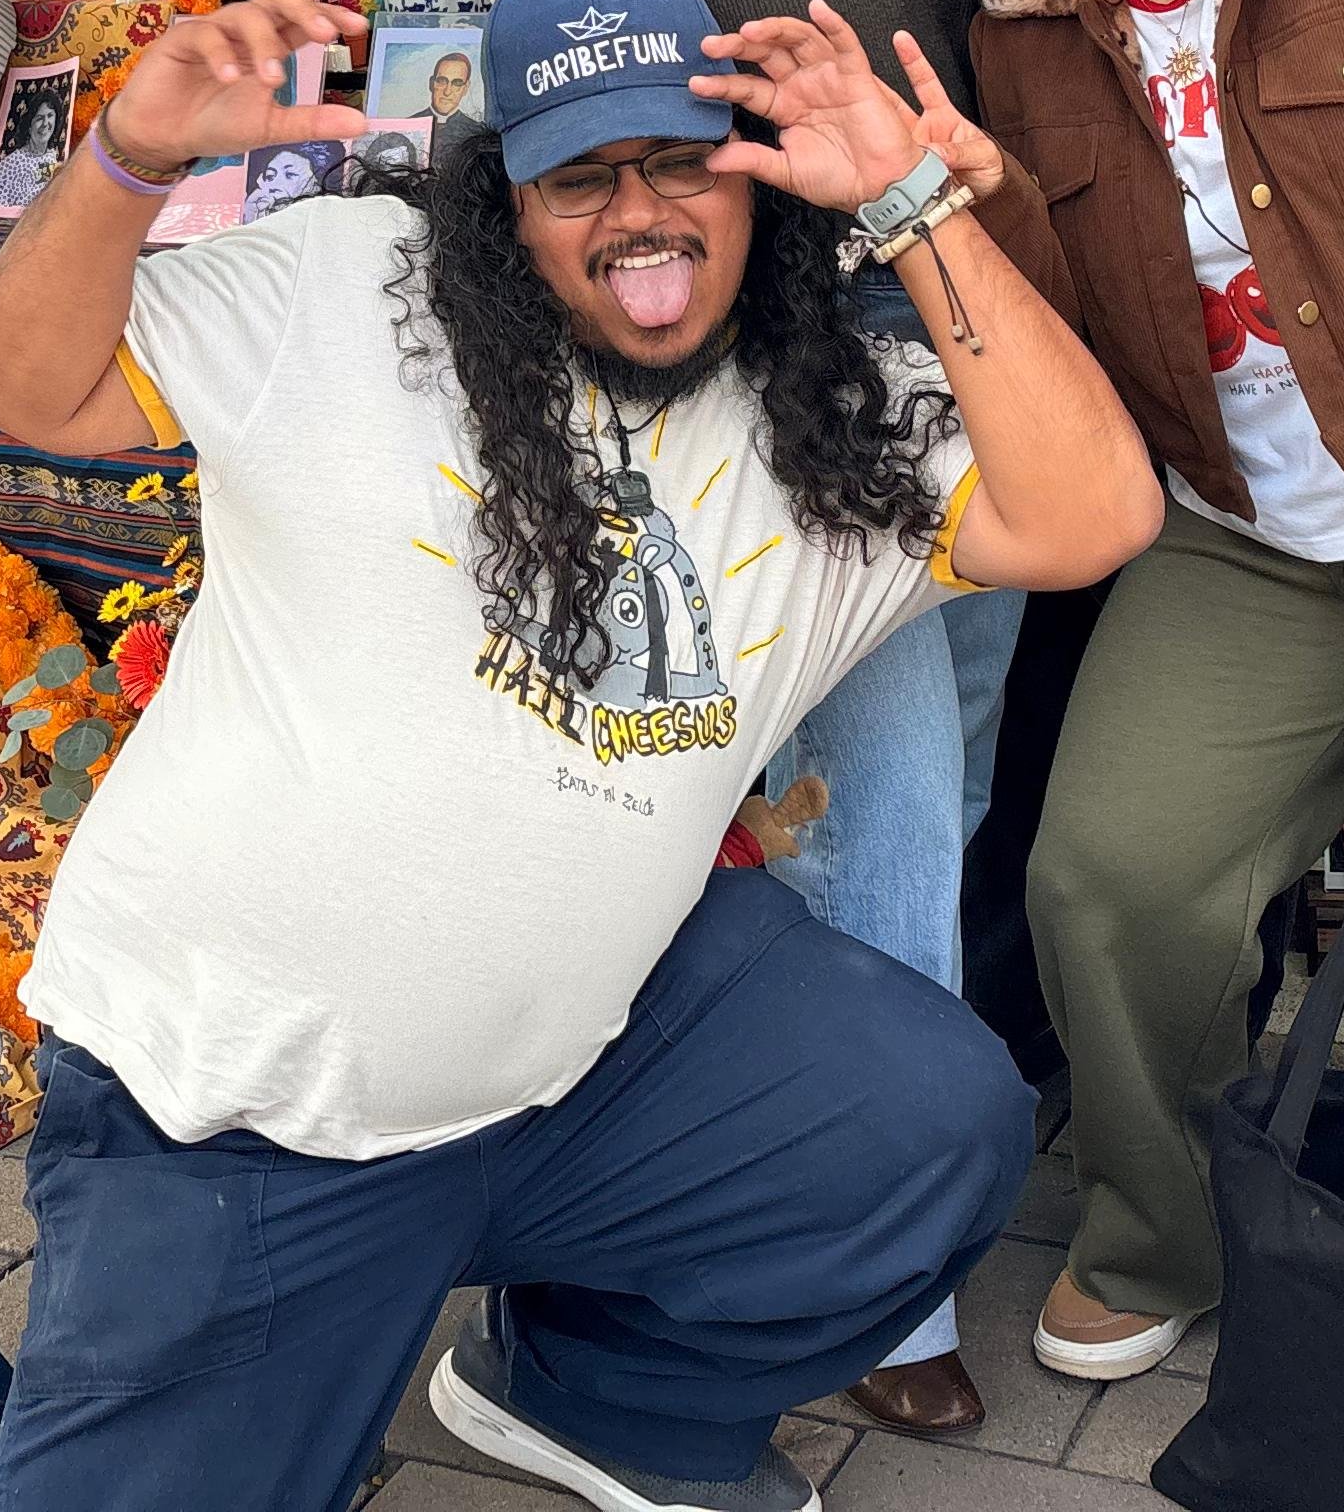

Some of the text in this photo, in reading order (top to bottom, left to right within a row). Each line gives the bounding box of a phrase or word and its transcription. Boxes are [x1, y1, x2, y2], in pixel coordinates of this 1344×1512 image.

[525, 32, 685, 97] CARIBEFUNK
[1228, 383, 1258, 396] HAVE
[1264, 383, 1275, 395] A
[592, 694, 738, 767] CHEESUS
